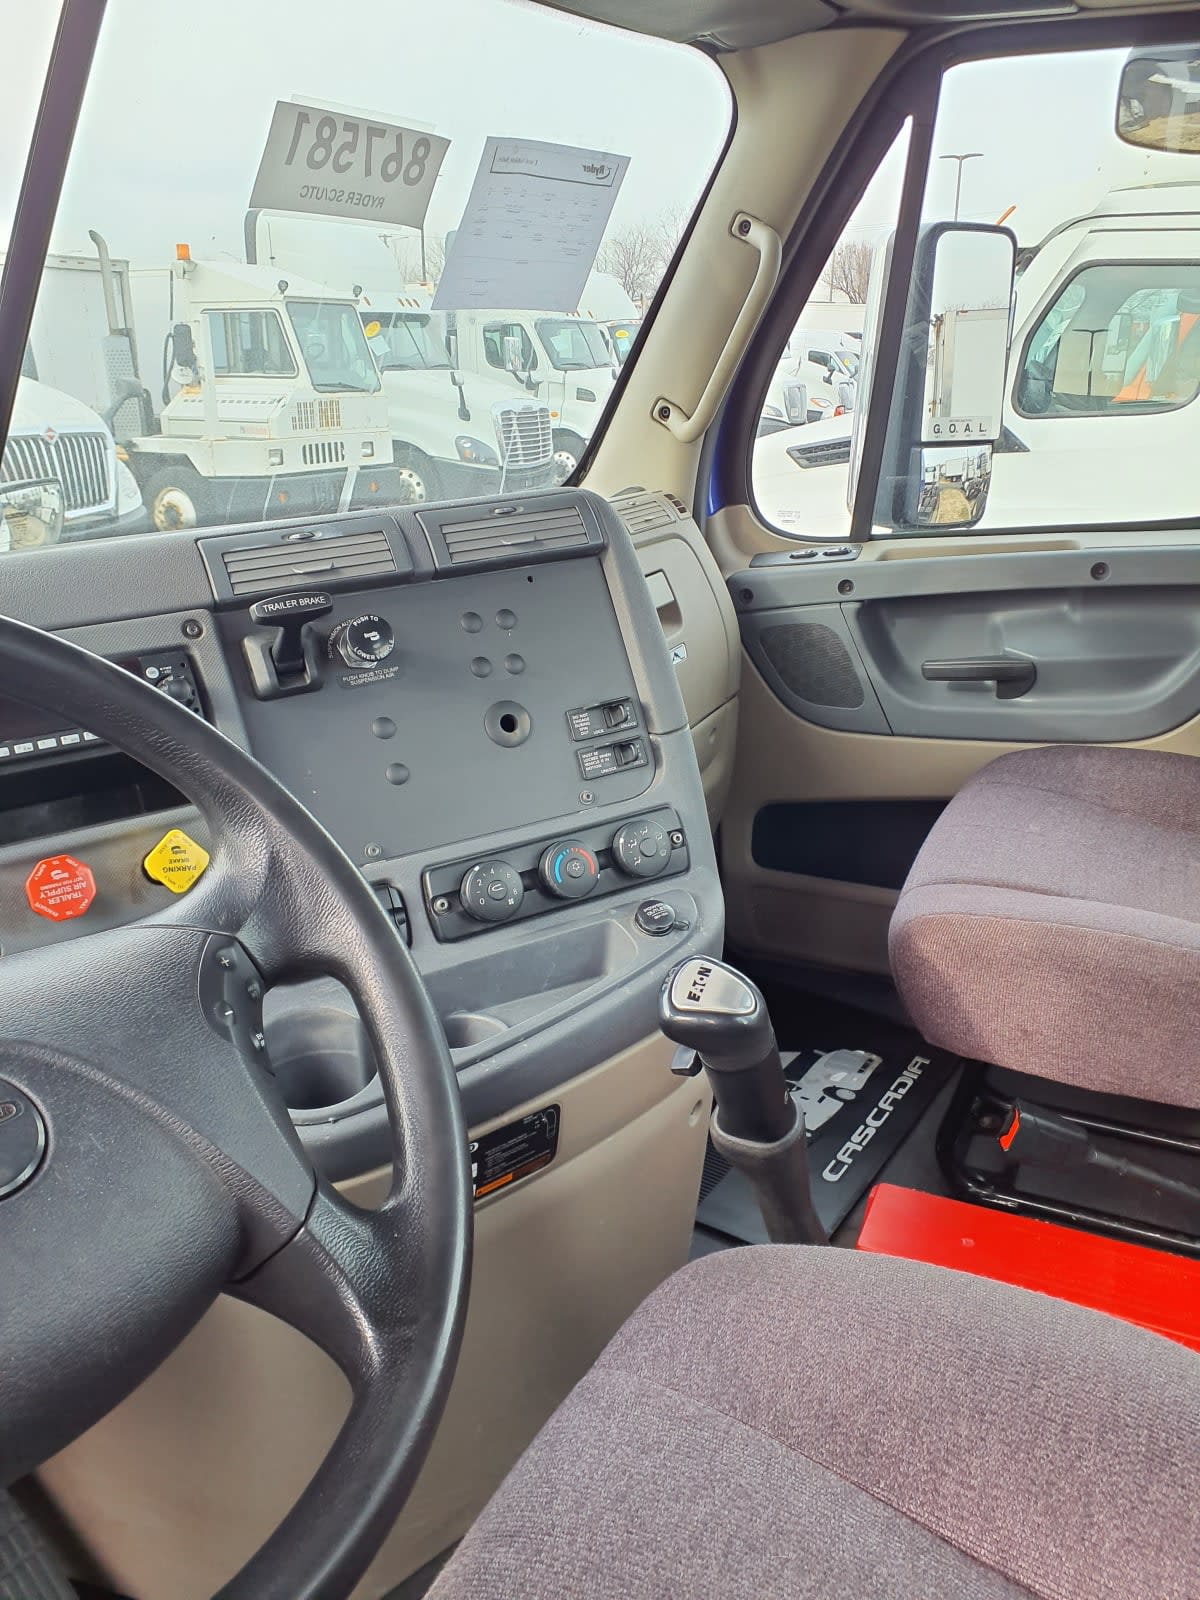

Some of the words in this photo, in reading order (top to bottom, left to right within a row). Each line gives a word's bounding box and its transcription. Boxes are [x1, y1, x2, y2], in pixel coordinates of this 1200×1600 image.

[933, 424, 943, 434] G.
[964, 423, 973, 433] A.
[979, 423, 987, 432] L.
[262, 600, 298, 613] TRAILER
[299, 596, 326, 607] BRAKE
[353, 615, 369, 627] PUSH
[353, 646, 376, 661] LOWER
[342, 673, 359, 681] PUSH
[384, 666, 399, 674] DUMP
[350, 673, 385, 686] SUSPENSION
[162, 864, 197, 873] PARKING
[40, 885, 72, 899] SUPPLY
[72, 881, 87, 890] AIR
[48, 891, 81, 905] TRAILER
[822, 1056, 931, 1182] CASCADIA
